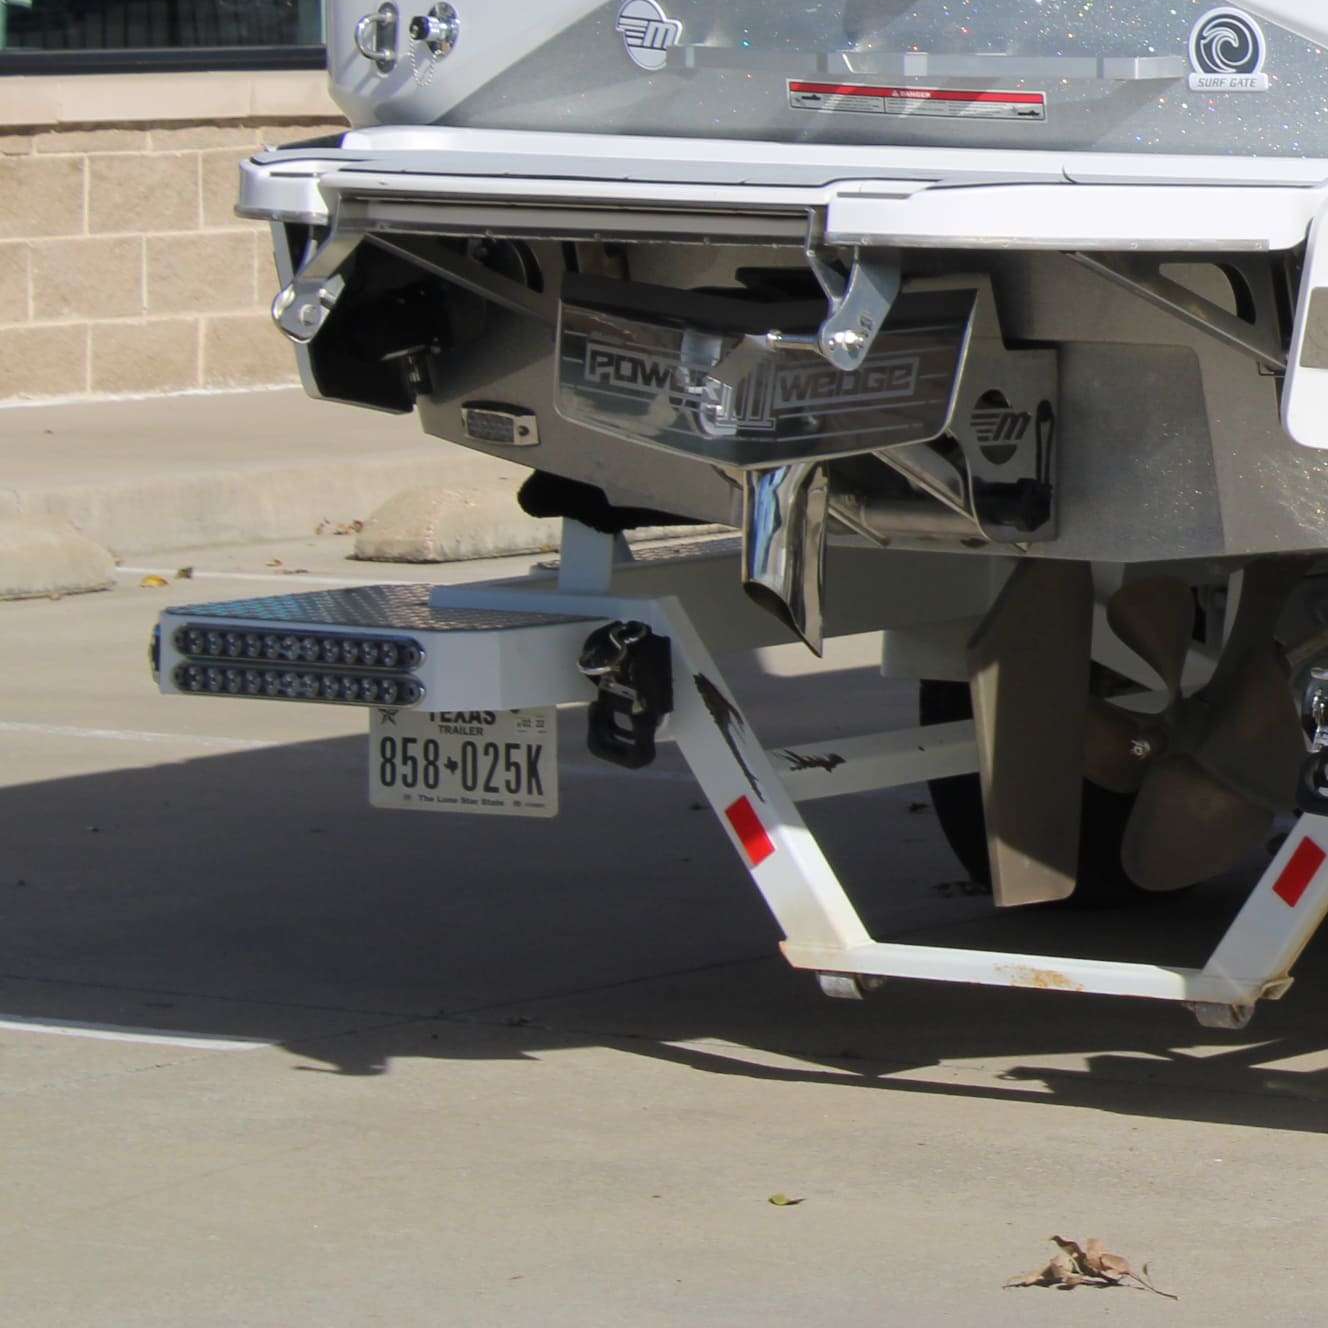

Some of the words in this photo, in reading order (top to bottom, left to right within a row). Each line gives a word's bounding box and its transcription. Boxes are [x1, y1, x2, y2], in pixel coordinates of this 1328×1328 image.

[1197, 77, 1226, 88] SURF
[1229, 77, 1257, 88] GATE
[438, 723, 484, 737] TRAILER
[380, 736, 440, 790] 858
[461, 740, 543, 796] 025K
